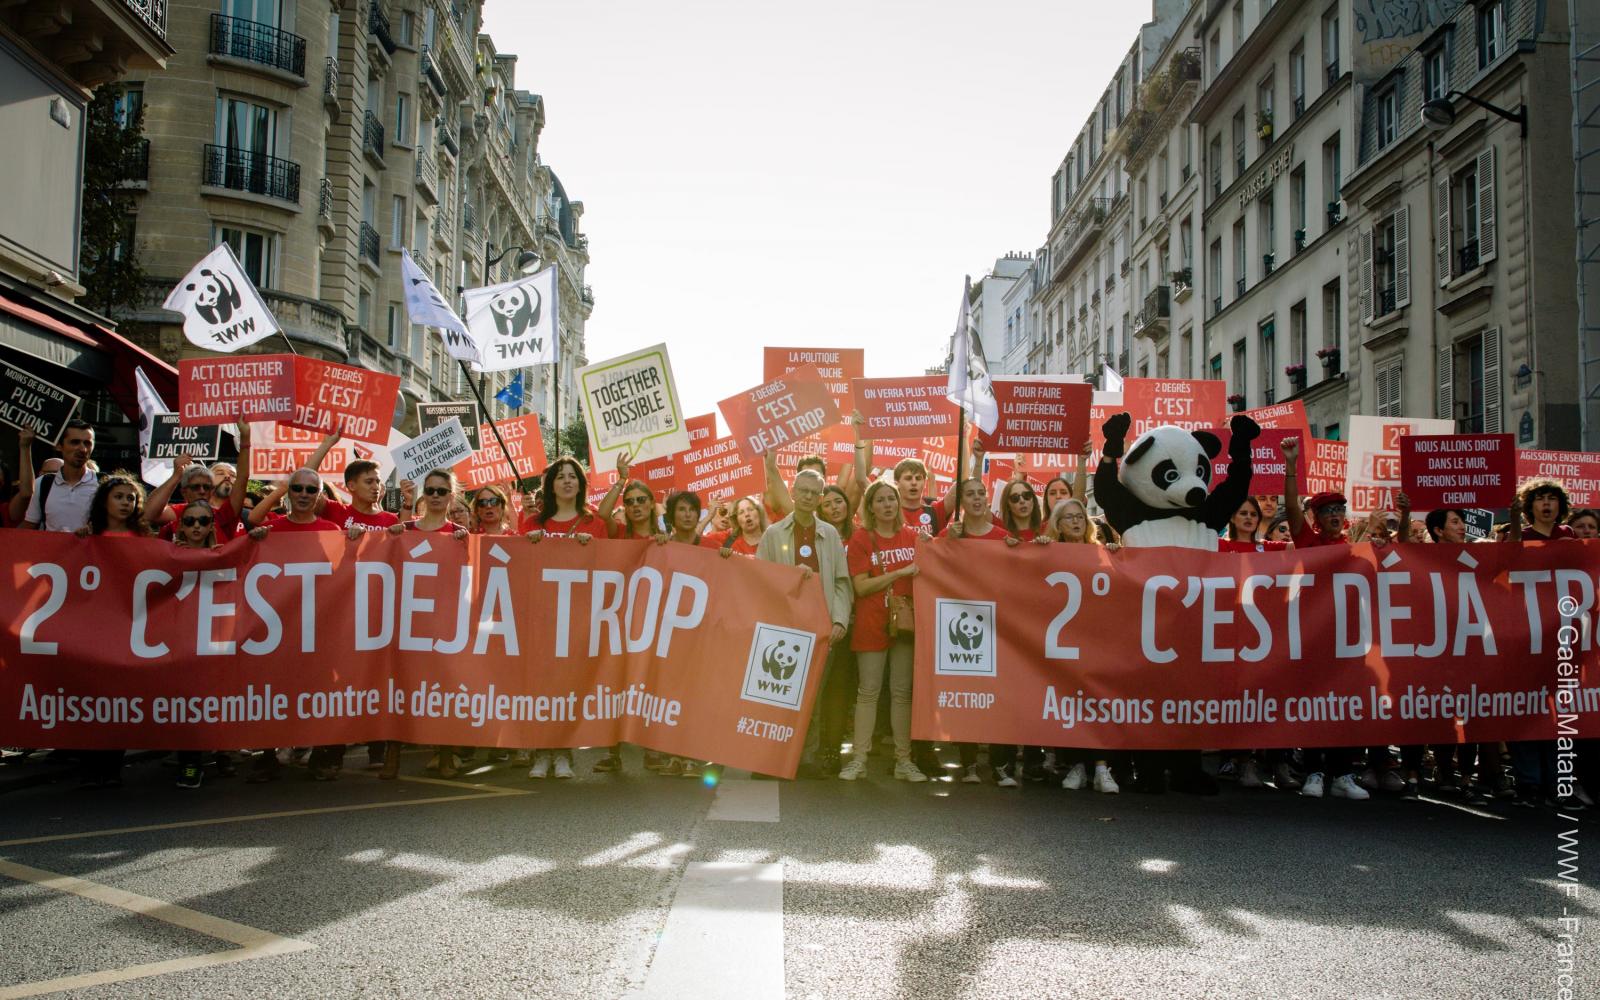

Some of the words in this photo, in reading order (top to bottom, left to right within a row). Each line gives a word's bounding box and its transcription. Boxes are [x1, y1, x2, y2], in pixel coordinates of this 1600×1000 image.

[789, 352, 799, 363] LA
[800, 352, 840, 364] POLITIQUE
[191, 365, 215, 381] ACT
[218, 361, 283, 379] TOGETHER
[323, 366, 330, 377] 2
[5, 368, 28, 385] MOINS
[27, 378, 38, 390] DE
[37, 383, 52, 397] BLA
[51, 390, 65, 402] BLA
[203, 383, 220, 398] TO
[223, 380, 272, 396] CHANGE
[591, 366, 661, 408] TOGETHER
[864, 388, 876, 399] ON
[877, 388, 904, 398] VERRA
[905, 386, 926, 397] PLUS
[1013, 386, 1037, 398] POUR
[1038, 387, 1062, 398] FAIRE
[1155, 382, 1160, 392] 2
[11, 387, 45, 412] PLUS
[318, 382, 363, 409] C'EST
[750, 392, 757, 402] 2
[185, 400, 240, 418] CLIMATE
[242, 397, 292, 414] CHANGE
[602, 390, 665, 431] POSSIBLE
[756, 393, 798, 424] C'EST
[886, 402, 906, 412] PLUS
[907, 401, 932, 412] TARD,
[1003, 402, 1014, 414] LA
[1016, 402, 1067, 417] DIFFÉRENCE,
[1154, 398, 1194, 416] C'EST
[1254, 404, 1295, 421] ENSEMBLE
[337, 412, 378, 438] TROP
[786, 407, 826, 438] TROP
[868, 417, 892, 428] C'EST
[893, 414, 946, 426] AUJOURD'HUI
[948, 414, 952, 424] !
[1006, 419, 1048, 432] METTONS
[1048, 421, 1062, 432] FIN
[172, 427, 198, 440] PLUS
[278, 425, 319, 441] CEST
[998, 433, 1004, 446] À
[1006, 434, 1069, 449] L'INDIFFÉRENCE
[1390, 427, 1406, 448] 2°
[156, 442, 210, 457] D'ACTIONS
[403, 447, 418, 460] ACT
[416, 426, 455, 452] TOGETHER
[1415, 440, 1440, 453] NOUS
[1440, 440, 1474, 452] ALLONS
[1474, 439, 1501, 452] DROIT
[256, 449, 296, 472] DÉJÀ
[300, 452, 342, 471] TOP
[413, 456, 424, 466] TO
[424, 439, 453, 458] CHANGE
[683, 451, 702, 464] NOUS
[703, 442, 728, 458] ALLONS
[884, 446, 918, 458] MASSIVE
[1256, 446, 1276, 460] DÉFI,
[1520, 451, 1558, 462] AGISSONS
[1560, 454, 1600, 464] ENSEMBLE
[407, 462, 438, 481] CLIMATE
[438, 442, 466, 466] CHANGE
[694, 463, 714, 476] DANS
[714, 460, 722, 470] LE
[723, 453, 742, 468] MUR,
[922, 449, 957, 474] TIONS
[1376, 458, 1401, 480] C'E
[1428, 458, 1452, 470] DANS
[1453, 458, 1464, 470] LE
[1466, 456, 1489, 470] MUR,
[1539, 462, 1580, 476] CONTRE
[468, 465, 496, 486] TOO
[688, 475, 718, 492] PRENONS
[718, 472, 729, 484] UN
[730, 464, 753, 480] AUTRE
[1416, 476, 1457, 488] PRENONS
[1458, 475, 1471, 486] UN
[1472, 474, 1501, 486] AUTRE
[1306, 477, 1326, 494] TOO
[1442, 492, 1476, 504] CHEMIN
[1465, 524, 1487, 538] TIONS
[20, 562, 100, 656] 2°
[130, 562, 333, 659] C'EST
[354, 540, 520, 656] DÉJÀ
[542, 566, 710, 658] TROP
[1045, 571, 1110, 660] 2°
[1141, 574, 1315, 664] C'EST
[1332, 550, 1498, 658] DÉJÀ
[1508, 568, 1600, 655] TR
[949, 652, 984, 664] WWF
[757, 680, 793, 696] WWF
[19, 684, 144, 729] Agissons
[152, 684, 288, 724] ensemble
[296, 684, 380, 720] contre
[388, 678, 405, 714] le
[410, 680, 578, 728] dérèglement
[938, 692, 995, 709] #2CTROP
[1042, 686, 1154, 729] Agissons
[1162, 688, 1278, 724] ensemble
[1284, 691, 1364, 722] contre
[1370, 686, 1392, 720] le
[1400, 684, 1550, 725] dérèglement
[736, 716, 794, 742] #2CTROP
